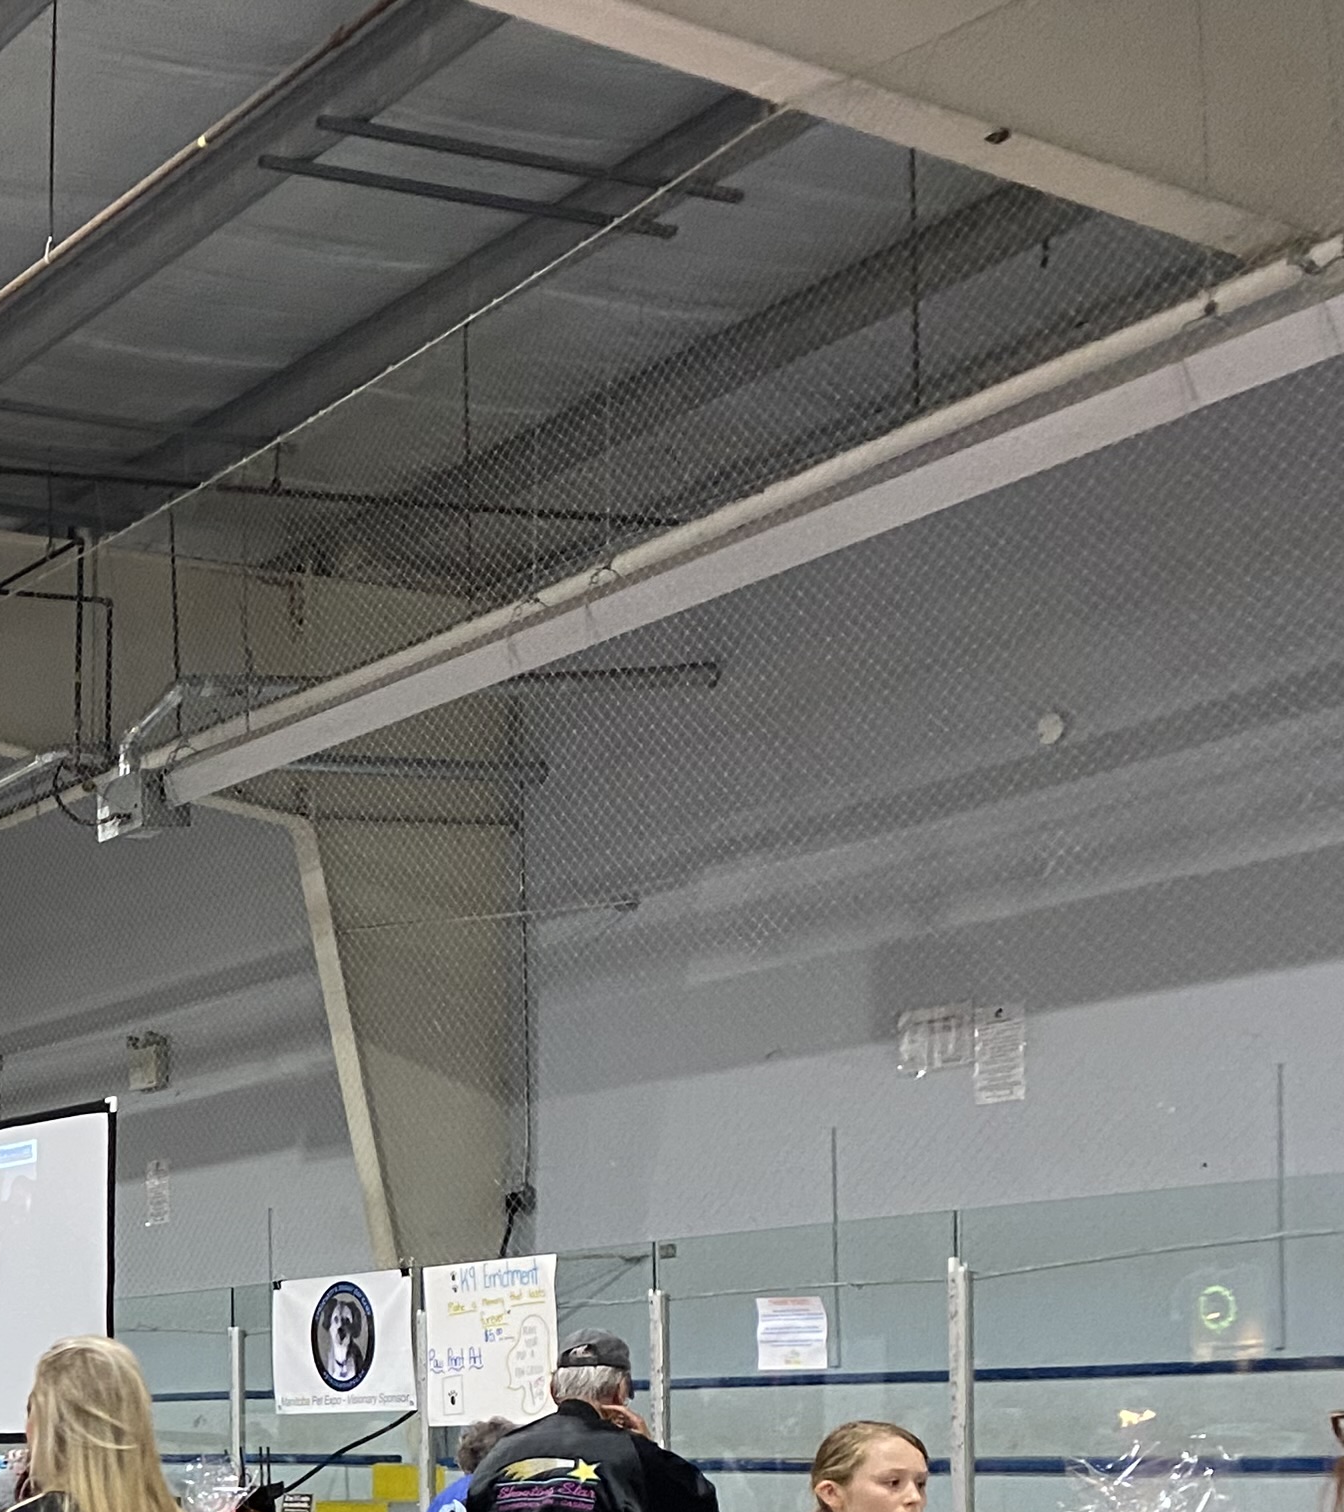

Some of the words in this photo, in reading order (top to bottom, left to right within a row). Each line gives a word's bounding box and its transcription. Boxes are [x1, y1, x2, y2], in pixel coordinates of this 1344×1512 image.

[460, 1266, 477, 1292] K9
[379, 1393, 410, 1404] Sponsor
[497, 1486, 554, 1500] Shooting
[558, 1481, 596, 1499] Star
